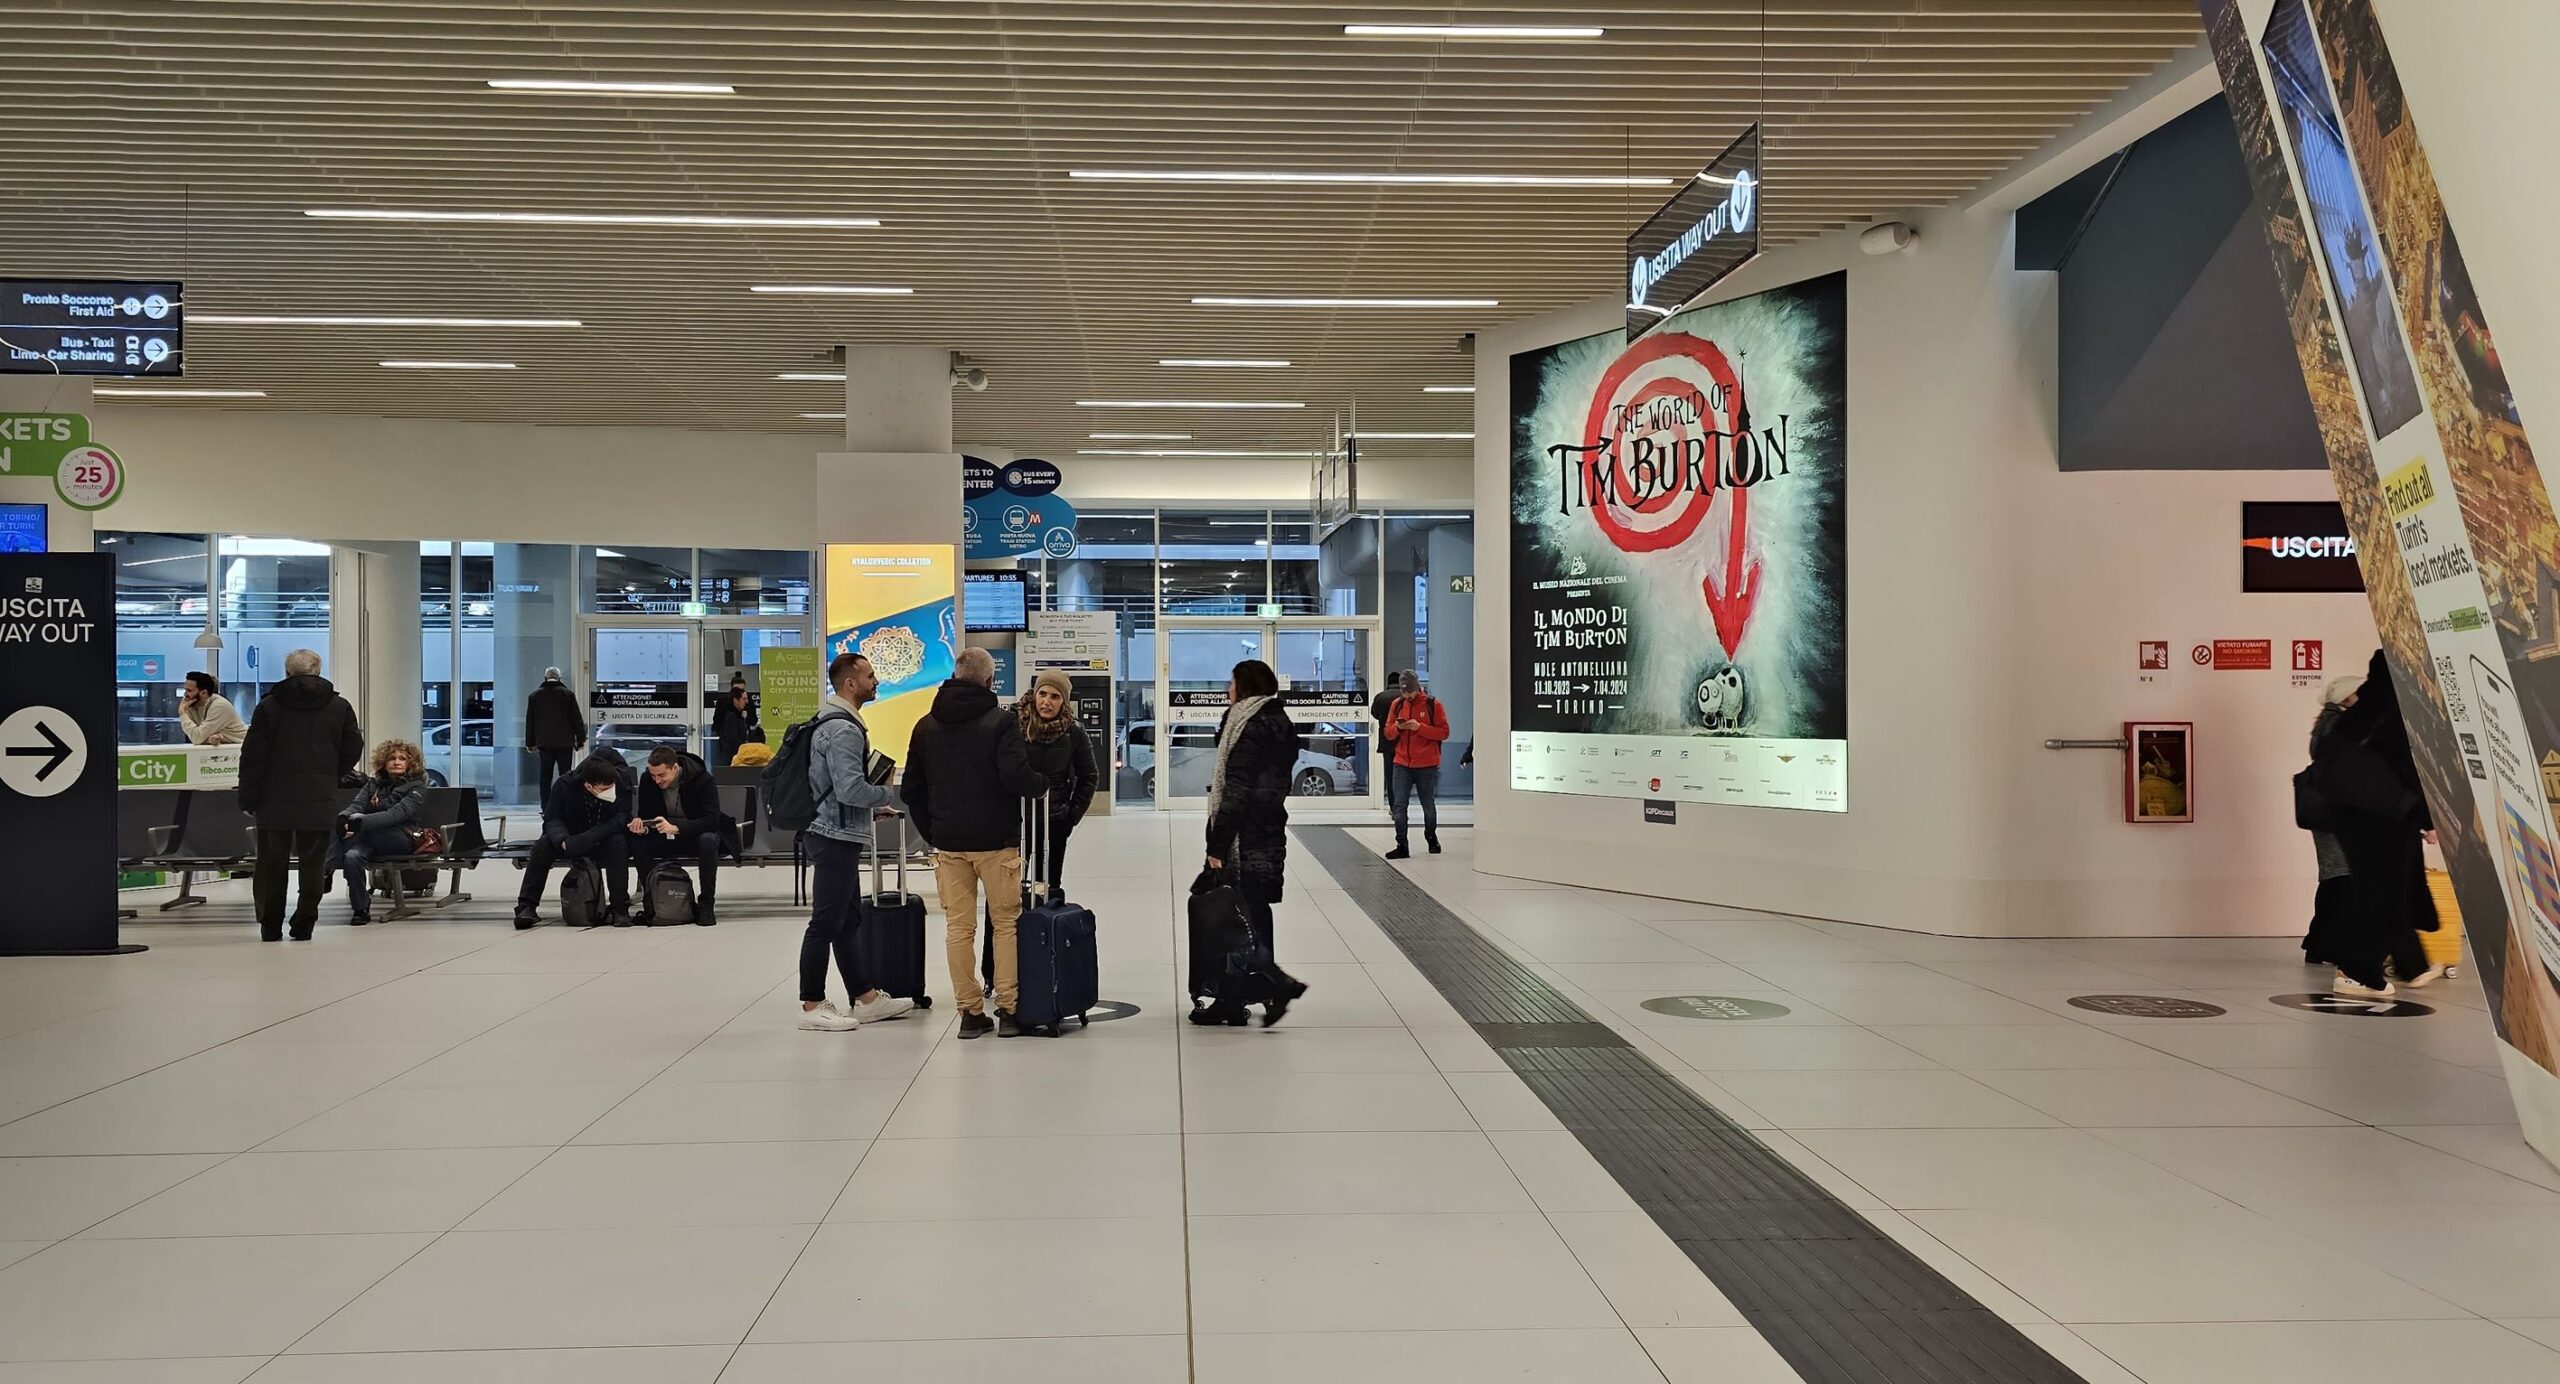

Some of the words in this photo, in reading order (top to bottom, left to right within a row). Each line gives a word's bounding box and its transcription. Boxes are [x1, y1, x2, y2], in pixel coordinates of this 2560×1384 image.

[1648, 239, 1680, 286] USCITA
[1680, 219, 1704, 260] WAY
[1704, 199, 1729, 242] OUT
[22, 293, 60, 304] Pronto
[61, 294, 114, 305] Soccorso
[69, 307, 94, 317] First
[95, 307, 114, 317] Aid
[61, 337, 84, 348] Bus
[91, 337, 114, 348] Taxi
[11, 350, 40, 360] Limo
[47, 350, 72, 360] Car
[72, 350, 115, 363] Sharing
[1613, 404, 1644, 434] THE
[1648, 389, 1704, 431] WORLD
[1710, 382, 1734, 414] OF
[1547, 437, 1616, 516] TIM
[1625, 414, 1790, 510] BURTON
[74, 466, 102, 483] 25
[1023, 477, 1033, 485] 15
[2384, 479, 2410, 516] Find
[2404, 472, 2423, 508] out
[2419, 463, 2435, 503] all
[7, 522, 34, 530] TURIN
[2395, 514, 2429, 552] Turin's
[1048, 541, 1071, 549] arriva
[2271, 536, 2356, 558] USCITA
[2405, 554, 2431, 588] local
[1539, 580, 1559, 589] MUSEO
[1559, 578, 1591, 588] NAZIONALE
[1591, 577, 1604, 586] DEL
[1604, 575, 1628, 584] CINEMA
[1566, 589, 1591, 598] PRESENTA
[1534, 610, 1548, 629] IL
[1551, 608, 1607, 629] MONDO
[1611, 605, 1628, 625] DI
[0, 623, 37, 643] AY
[41, 623, 95, 643] OUT
[1534, 630, 1561, 650] TIM
[1564, 627, 1628, 649] BURTON
[1534, 662, 1556, 677] MOLE
[1560, 661, 1628, 677] ANTONELLIANA
[769, 677, 818, 687] TORINO
[1534, 680, 1570, 696] 11.10.2023
[1593, 680, 1628, 695] 7.04.2024
[1556, 699, 1604, 714] TORINO
[129, 759, 176, 783] City
[1645, 807, 1674, 817] IGPDecaux
